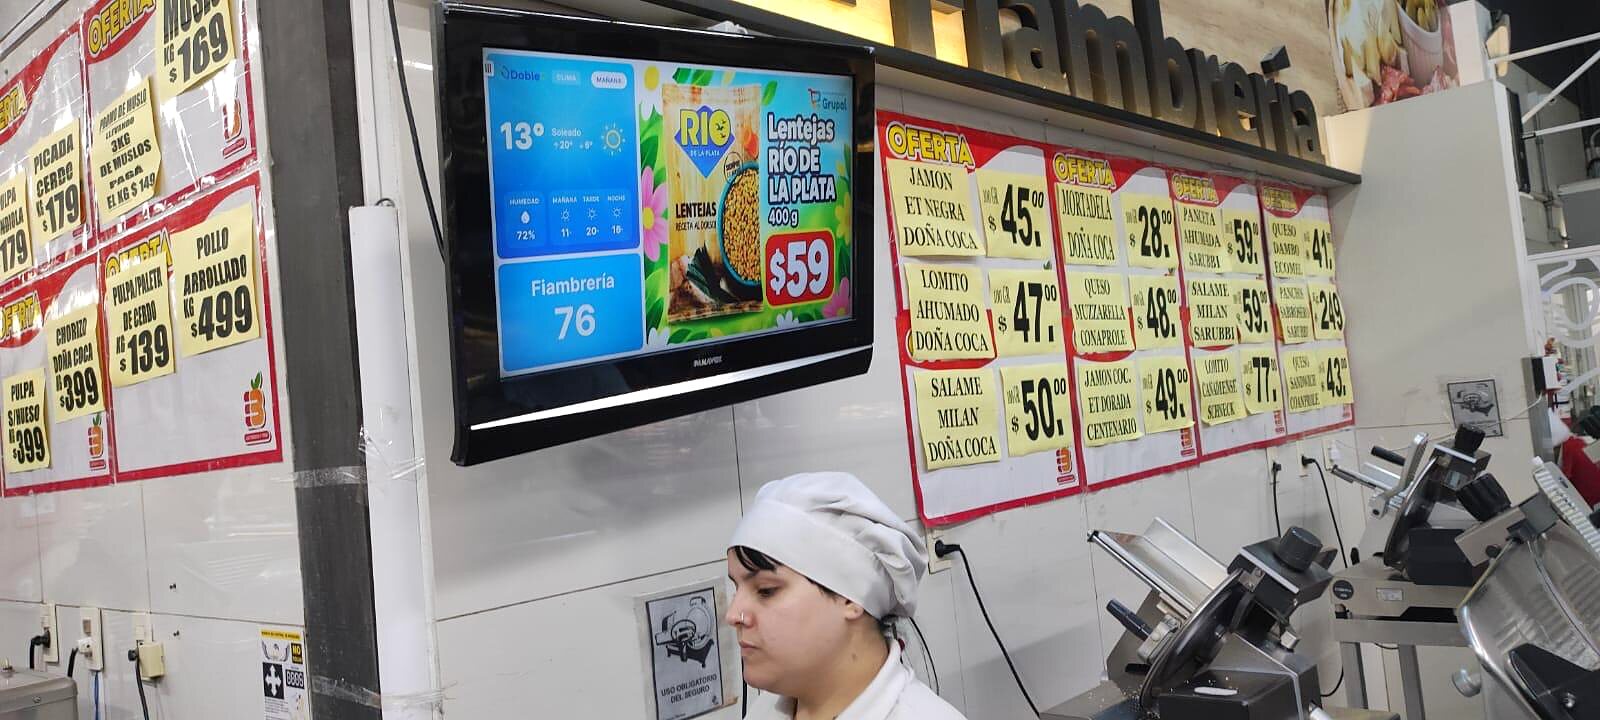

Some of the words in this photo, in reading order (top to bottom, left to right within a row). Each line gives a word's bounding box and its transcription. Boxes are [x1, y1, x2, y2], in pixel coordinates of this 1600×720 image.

[164, 43, 175, 66] KG
[551, 127, 582, 138] Soleado
[680, 108, 732, 147] RIO
[767, 113, 835, 143] Lentejas
[33, 133, 74, 175] PICADA
[110, 132, 131, 153] 3KG
[887, 123, 976, 168] OFERTA
[99, 161, 113, 178] DE
[113, 139, 152, 171] MUSLOS
[768, 139, 798, 174] RÍO
[799, 148, 820, 173] DE
[109, 164, 144, 190] PAGA
[909, 167, 953, 190] JAMON
[1054, 153, 1116, 189] OFERTA
[106, 191, 117, 210] EL
[117, 185, 130, 202] KG
[768, 177, 791, 203] LA
[791, 175, 837, 202] PLATA
[675, 202, 717, 219] LENTEJAS
[768, 207, 789, 226] 400
[790, 211, 799, 227] g
[905, 196, 924, 215] ET
[924, 198, 966, 221] NEGRA
[1062, 189, 1113, 221] MORTADELA
[1183, 207, 1216, 226] PANCETA
[516, 229, 536, 241] 72%
[904, 222, 943, 248] DOÑA
[944, 230, 978, 250] COCA
[1184, 229, 1222, 248] AHUMADA
[1272, 222, 1297, 238] QUESO
[197, 226, 230, 260] POLLO
[1067, 227, 1094, 259] DOÑA
[1094, 233, 1115, 261] COCA
[1273, 241, 1300, 256] DAMBO
[184, 254, 248, 297] ARROLLADO
[770, 238, 829, 298] $59
[112, 266, 163, 307] PULPA/PALETA
[531, 273, 615, 297] Fiambrería
[921, 269, 969, 293] LOMITO
[1084, 278, 1111, 298] QUESO
[1191, 281, 1230, 297] SALAME
[123, 311, 133, 332] DE
[133, 300, 157, 328] CERDO
[184, 296, 195, 319] KG
[916, 299, 980, 322] AHUMADO
[1074, 304, 1126, 320] MUZZARELLA
[1196, 304, 1228, 319] MILAN
[1319, 290, 1343, 331] 249
[56, 317, 87, 346] CHORIZO
[554, 304, 596, 340] 76
[1193, 326, 1235, 341] SARUBBI
[116, 335, 126, 354] KG
[915, 327, 953, 351] DOÑA
[954, 331, 989, 351] COCA
[1080, 329, 1128, 346] CONAPROLE
[53, 349, 72, 374] DOÑA
[72, 342, 94, 367] COCA
[1204, 357, 1229, 374] LOMITO
[931, 376, 983, 398] SALAME
[1085, 369, 1113, 387] JAMON
[1113, 368, 1132, 384] COC.
[11, 379, 35, 402] PULPA
[1088, 397, 1101, 413] ET
[1101, 393, 1131, 412] DORADA
[8, 404, 40, 427] S/HUESO
[937, 407, 979, 429] MILAN
[1087, 417, 1137, 441] CENTENARIO
[927, 435, 964, 462] DOÑA
[964, 436, 998, 457] COCA
[661, 684, 676, 697] USO
[676, 673, 718, 692] OBLIGATORIO
[670, 693, 682, 704] DEL
[684, 685, 710, 699] SEGURO
